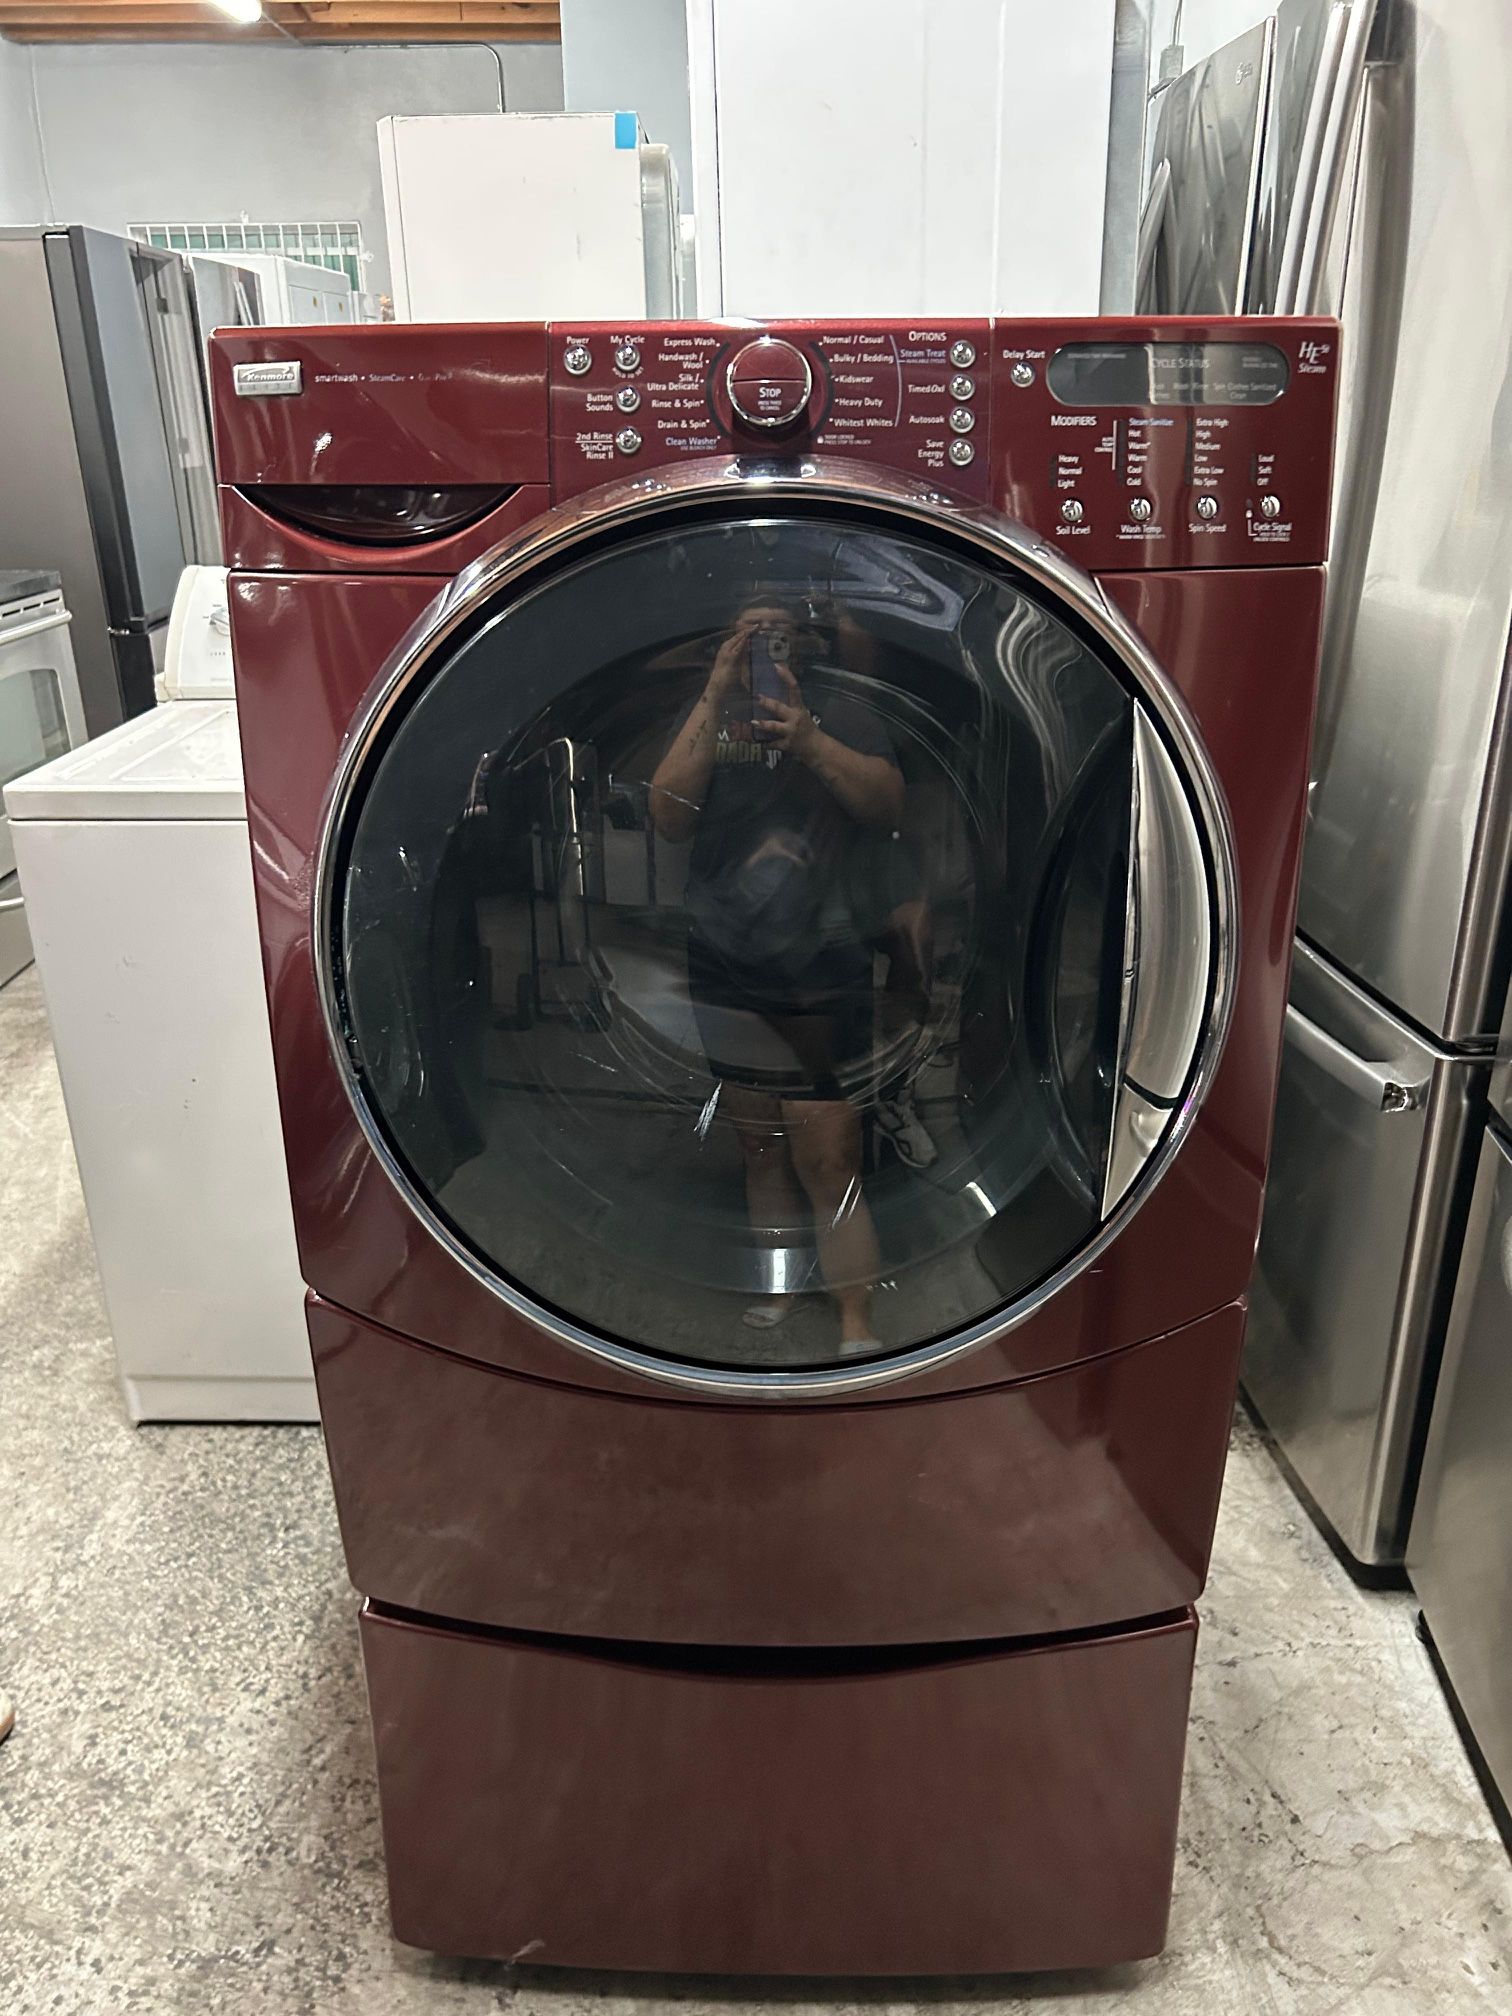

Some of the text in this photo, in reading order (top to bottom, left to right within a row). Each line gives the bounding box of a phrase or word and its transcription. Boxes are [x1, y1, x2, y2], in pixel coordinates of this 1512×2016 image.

[566, 336, 589, 344] Power
[610, 335, 645, 345] My Cycle
[823, 335, 851, 343] Normal
[859, 335, 884, 343] Casual
[909, 331, 947, 341] OPTIONS
[664, 337, 716, 347] Express Wash
[658, 353, 697, 361] Handwash
[900, 348, 946, 358] Steam Treat
[1003, 350, 1045, 359] Delay Start
[834, 354, 856, 364] Bulky
[862, 354, 894, 364] Bedding
[682, 361, 703, 369] Wool
[1298, 363, 1327, 374] Steam
[247, 372, 294, 382] Kenmore
[315, 374, 358, 383] smartwash
[678, 373, 693, 382] Silk
[840, 374, 873, 383] Kidswear
[647, 382, 699, 391] Ultra Delicate
[759, 387, 781, 398] STOP
[587, 394, 613, 402] Button
[839, 397, 883, 407] Heavy Duty
[586, 403, 613, 412] Sounds
[651, 399, 700, 409] Rinse & Spin
[834, 418, 893, 427] Whitest Whites
[909, 415, 945, 423] Autosoak
[1051, 416, 1097, 426] MODIFIERS
[1196, 418, 1229, 428] Extra High
[657, 420, 707, 430] Drain & Spin
[576, 432, 613, 440] 2nd Rinse
[1195, 430, 1211, 439] High
[665, 437, 717, 446] Clean Washer
[926, 439, 944, 448] Save
[1195, 442, 1220, 450] Medium
[581, 443, 614, 452] SkinCare
[586, 451, 606, 460] Rinse
[918, 449, 944, 459] Energy
[1258, 454, 1275, 462] Loud
[928, 459, 944, 467] Plus
[1058, 455, 1078, 463] Heavy
[1058, 467, 1082, 475] Normal
[1194, 466, 1224, 474] Extra Low
[1258, 466, 1272, 474] Soft
[1058, 479, 1075, 489] Light
[1193, 478, 1218, 487] No Spin
[1056, 526, 1091, 535] Soil Level
[1121, 525, 1162, 534] Wash Temp
[1189, 524, 1227, 534] Spin Speed
[1253, 522, 1271, 532] Cycle
